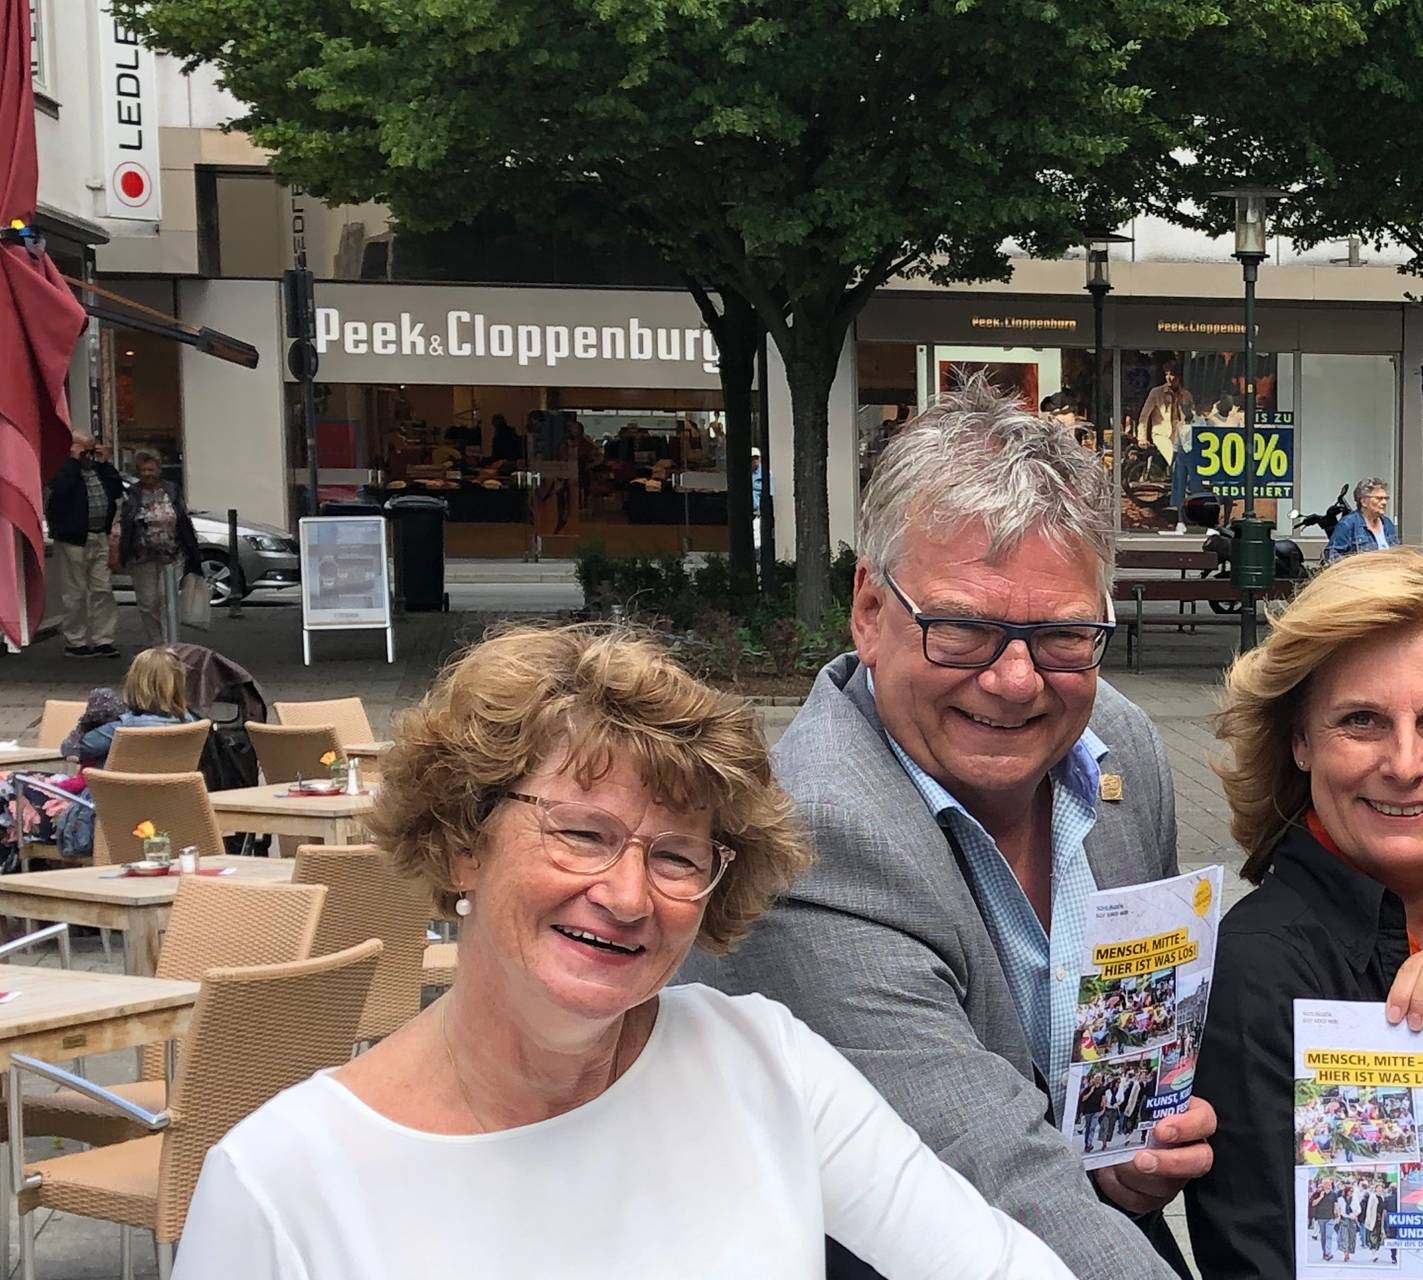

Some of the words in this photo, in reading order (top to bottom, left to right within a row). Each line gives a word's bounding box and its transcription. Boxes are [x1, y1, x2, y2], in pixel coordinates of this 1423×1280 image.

[113, 18, 143, 151] LEDLE
[1274, 413, 1292, 423] ZU
[1196, 431, 1288, 477] 30%
[1096, 942, 1150, 961] MENSCH,
[1151, 932, 1180, 951] MITTE
[1104, 963, 1133, 977] HIER
[1135, 957, 1152, 972] IST
[1154, 951, 1177, 968] WAS
[1177, 943, 1197, 960] LOS!
[1307, 1053, 1371, 1067] MENSCH,
[1374, 1055, 1415, 1067] MITTE
[1319, 1070, 1351, 1082] HIER
[1354, 1071, 1376, 1083] IST
[1378, 1072, 1411, 1084] WAS
